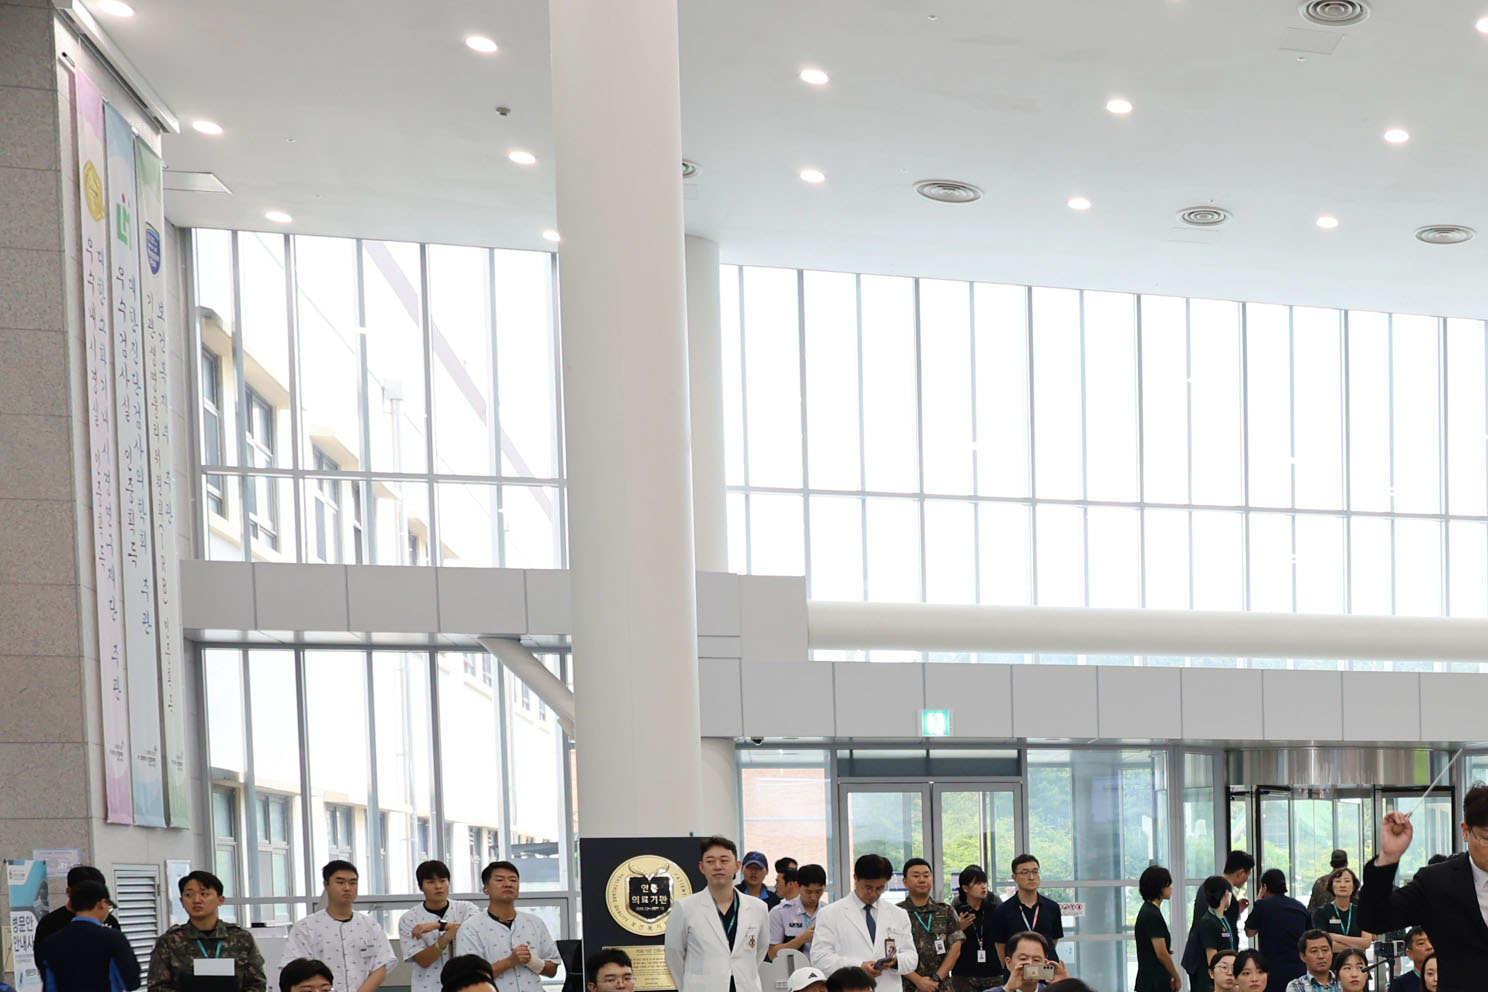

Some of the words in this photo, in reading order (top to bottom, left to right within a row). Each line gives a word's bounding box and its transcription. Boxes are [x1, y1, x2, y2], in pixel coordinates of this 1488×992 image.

[116, 266, 130, 423] 우수검사실
[124, 444, 138, 568] 인증획득
[128, 276, 147, 554] 대한진단검사의학회
[141, 578, 152, 635] 주관
[675, 872, 687, 896] PATIENT
[631, 894, 669, 905] 의료기관
[614, 904, 629, 921] QUALITY
[12, 915, 33, 934] 병문안
[631, 921, 667, 932] 보건복지
[14, 934, 34, 953] 안내사
